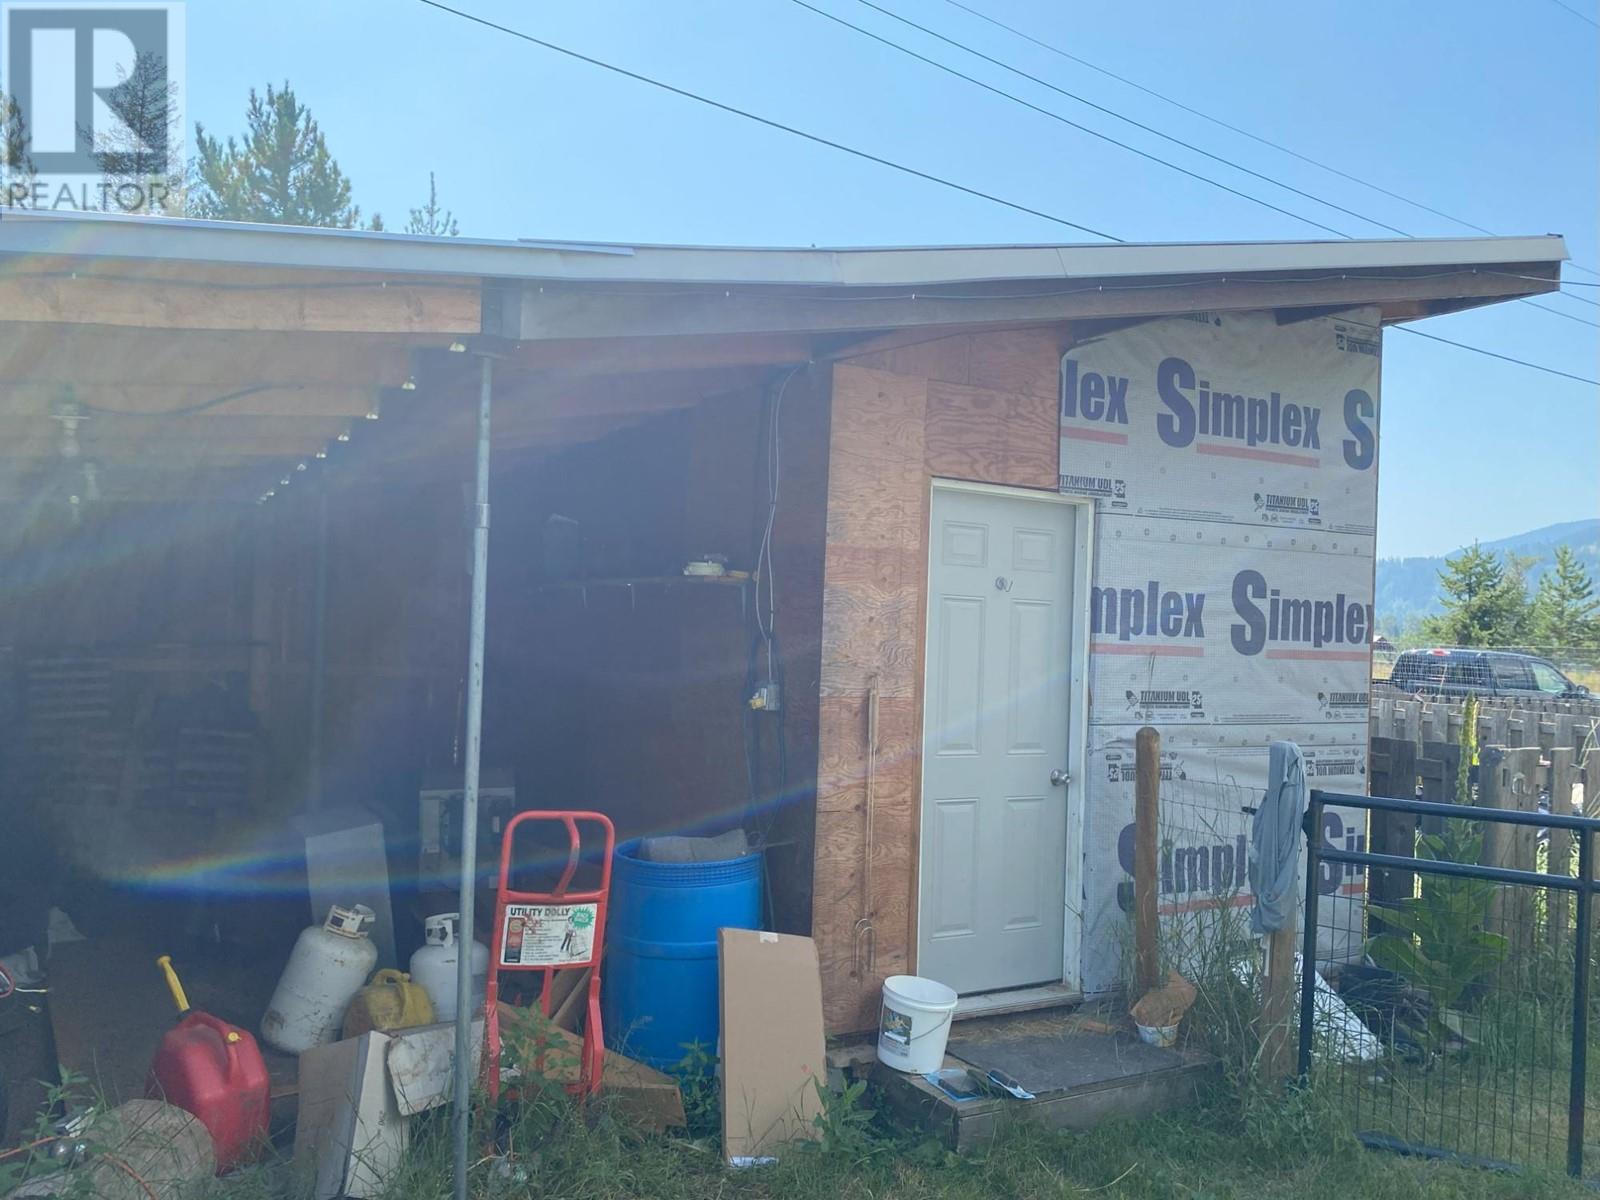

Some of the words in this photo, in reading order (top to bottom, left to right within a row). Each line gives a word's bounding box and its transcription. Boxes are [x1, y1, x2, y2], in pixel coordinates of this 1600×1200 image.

[1060, 359, 1128, 424] lex
[1157, 356, 1320, 449] Simplex
[1266, 494, 1295, 506] TITANIUM
[1140, 690, 1175, 702] TITANIUM
[1176, 690, 1190, 702] UDL
[510, 907, 543, 917] UTILITY
[544, 907, 571, 917] DOLLY
